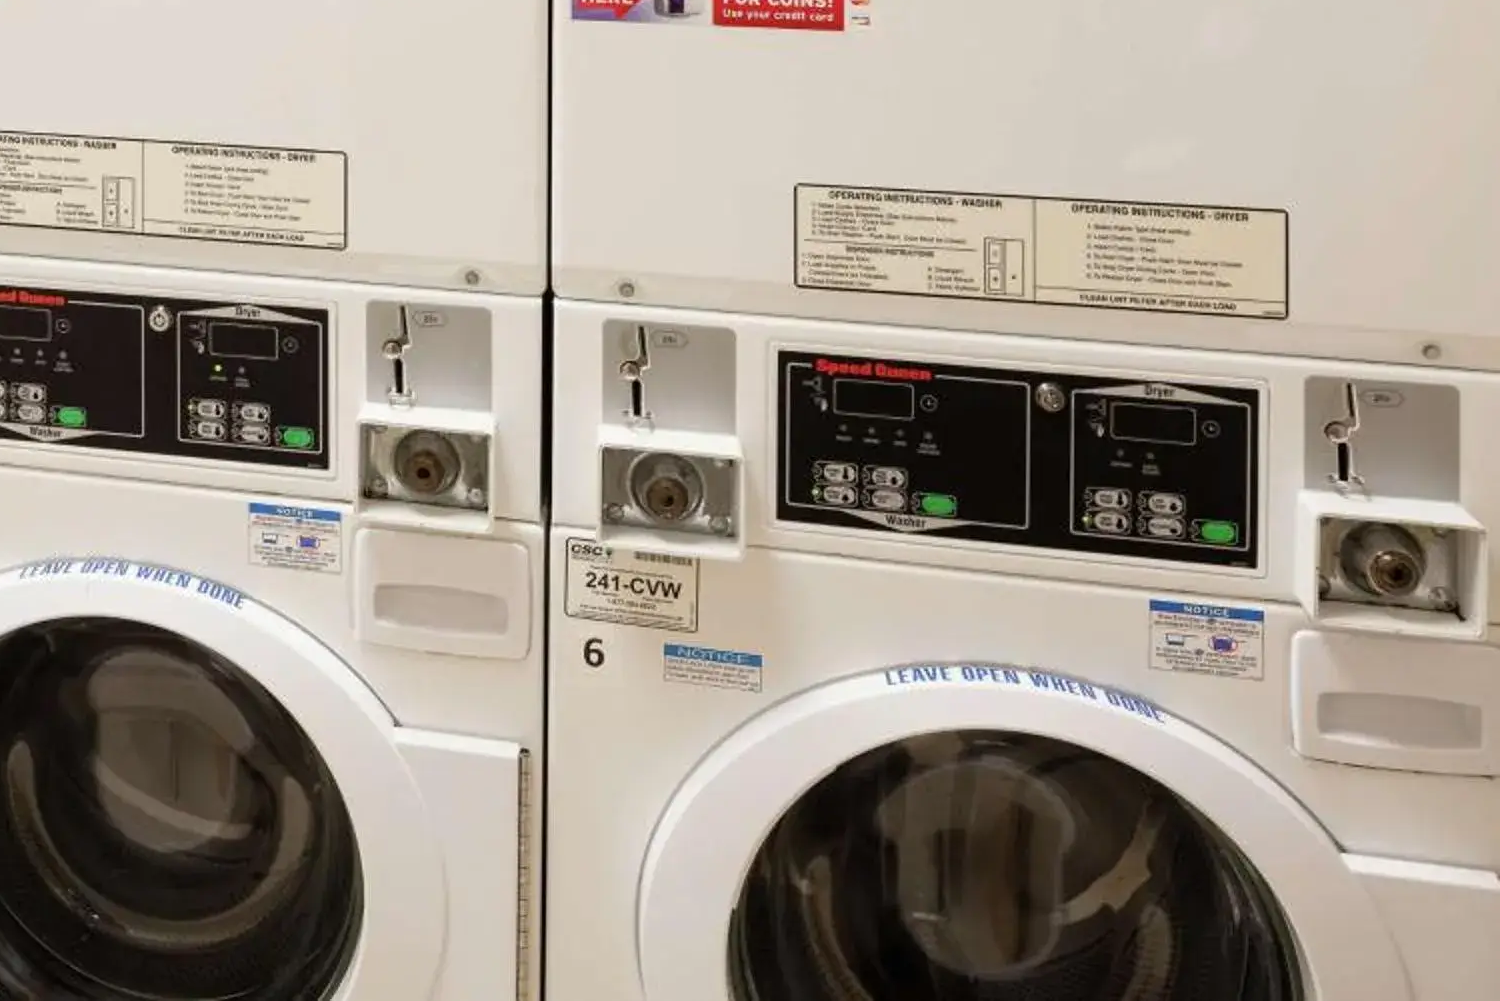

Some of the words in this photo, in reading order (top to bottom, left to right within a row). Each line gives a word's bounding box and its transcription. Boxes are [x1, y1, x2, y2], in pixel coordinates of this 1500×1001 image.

[722, 7, 743, 19] Use
[171, 145, 220, 159] OPERATING
[221, 148, 281, 162] INSTRUCTIONS
[828, 190, 883, 203] OPERATING
[884, 192, 954, 206] INSTRUCTIONS
[961, 197, 1003, 209] WASHER
[1071, 203, 1129, 216] OPERATING
[1131, 206, 1205, 221] INSTRUCTIONS
[1214, 212, 1249, 222] DRYER
[815, 359, 873, 376] Speed
[875, 363, 932, 381] Queen
[1144, 385, 1176, 398] Dryer
[29, 426, 63, 438] Washer
[885, 514, 927, 529] Washer
[571, 544, 603, 556] CSC
[19, 560, 73, 580] LEAVE
[80, 560, 129, 576] OPEN
[137, 566, 192, 589] WHEN
[197, 580, 247, 610] DONE
[585, 572, 682, 599] 241-CVW
[1183, 604, 1231, 618] NOTICE
[583, 636, 605, 668] 6
[885, 666, 952, 686] LEAVE
[961, 666, 1020, 684] OPEN
[1029, 672, 1098, 700] WHEN
[1106, 692, 1167, 724] DONE
